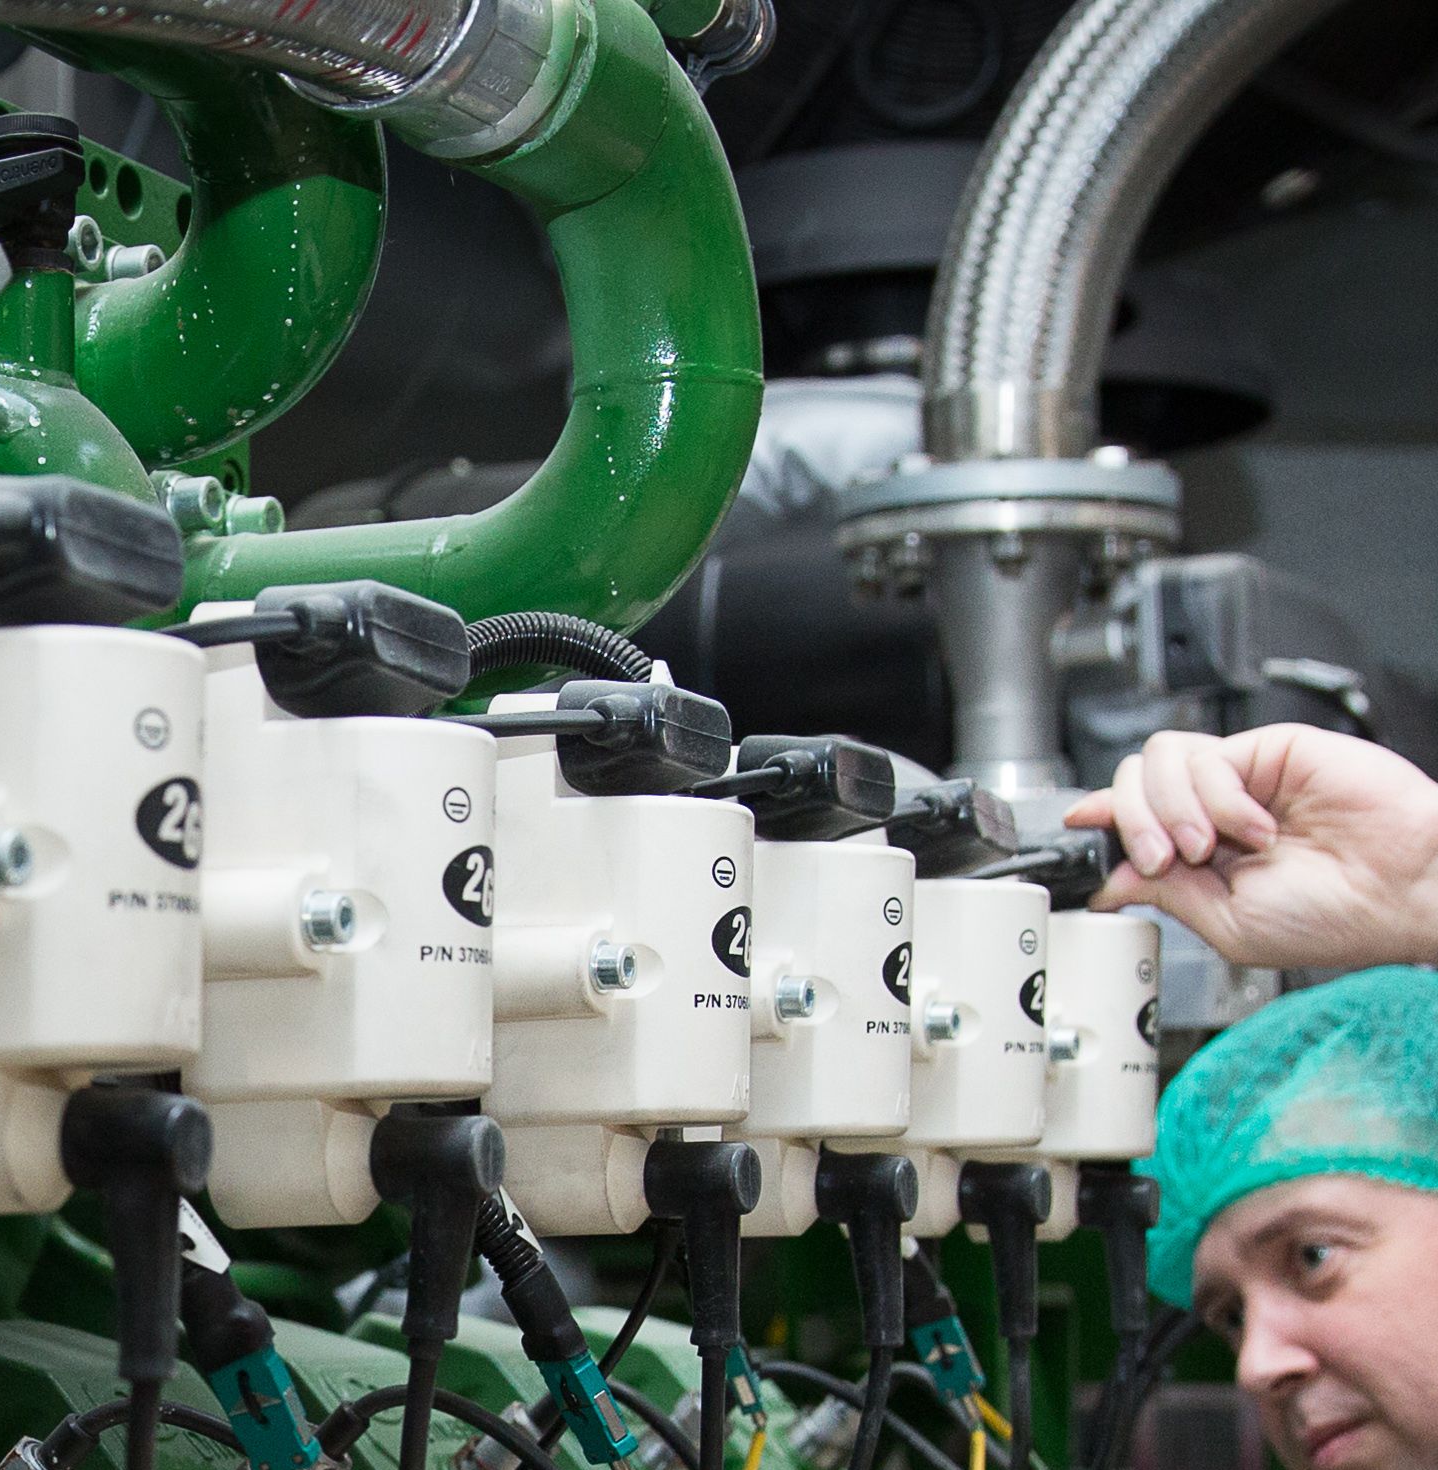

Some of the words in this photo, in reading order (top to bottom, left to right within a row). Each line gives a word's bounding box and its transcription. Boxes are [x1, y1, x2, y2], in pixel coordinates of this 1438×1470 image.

[420, 945, 453, 961] P/N
[694, 993, 721, 1009] P/N
[866, 1020, 889, 1034] P/N
